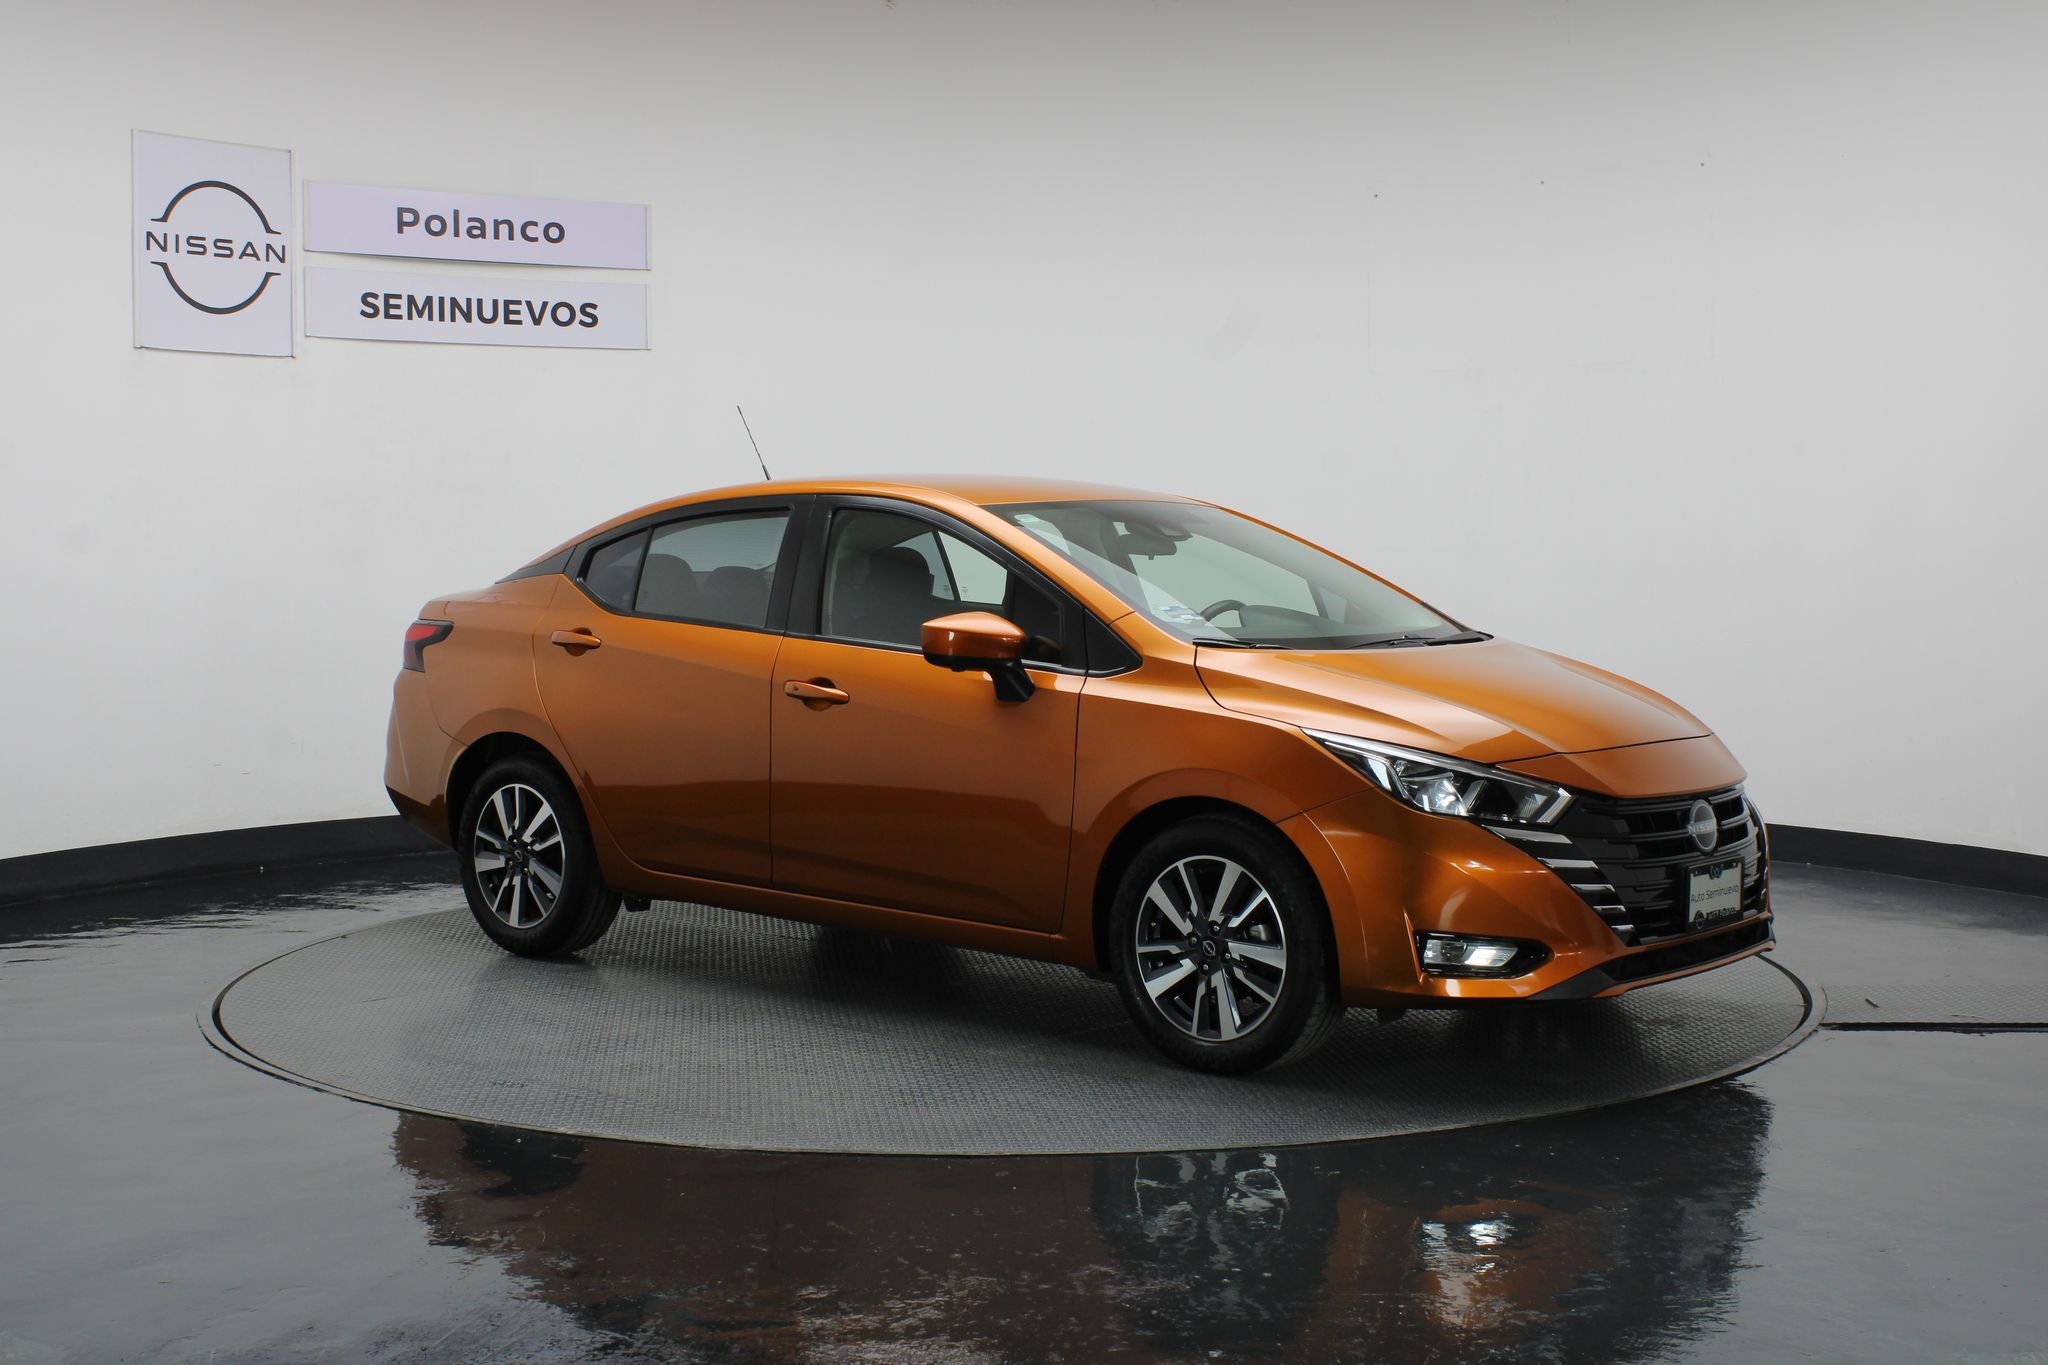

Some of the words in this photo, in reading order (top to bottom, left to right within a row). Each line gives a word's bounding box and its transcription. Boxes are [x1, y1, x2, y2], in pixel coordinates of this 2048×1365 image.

[397, 206, 566, 244] Polanco
[146, 230, 286, 264] NISSAN
[359, 291, 599, 328] SEMINUEVOS
